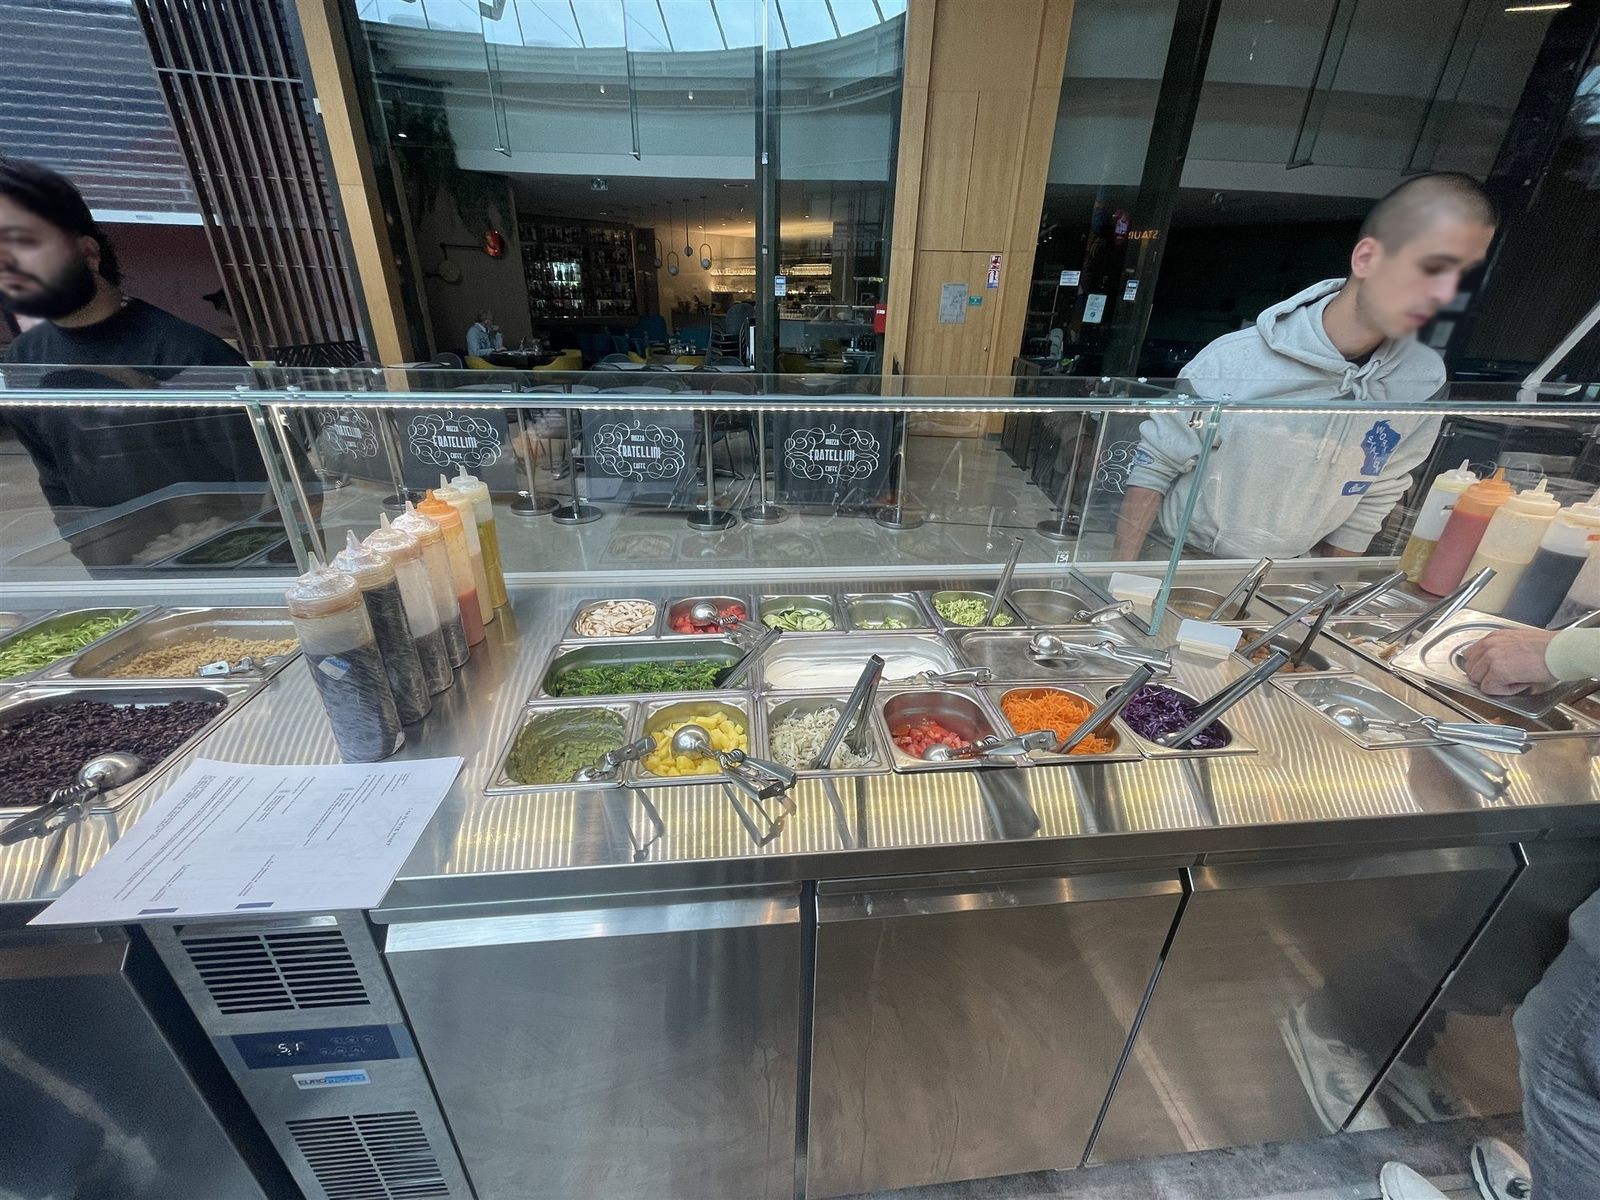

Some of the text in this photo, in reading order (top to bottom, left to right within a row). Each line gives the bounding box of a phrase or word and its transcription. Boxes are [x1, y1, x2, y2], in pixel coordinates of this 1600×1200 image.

[432, 435, 478, 449] FRATELLINI
[617, 444, 661, 459] FRATELLINI
[809, 448, 855, 462] FRATELLINI
